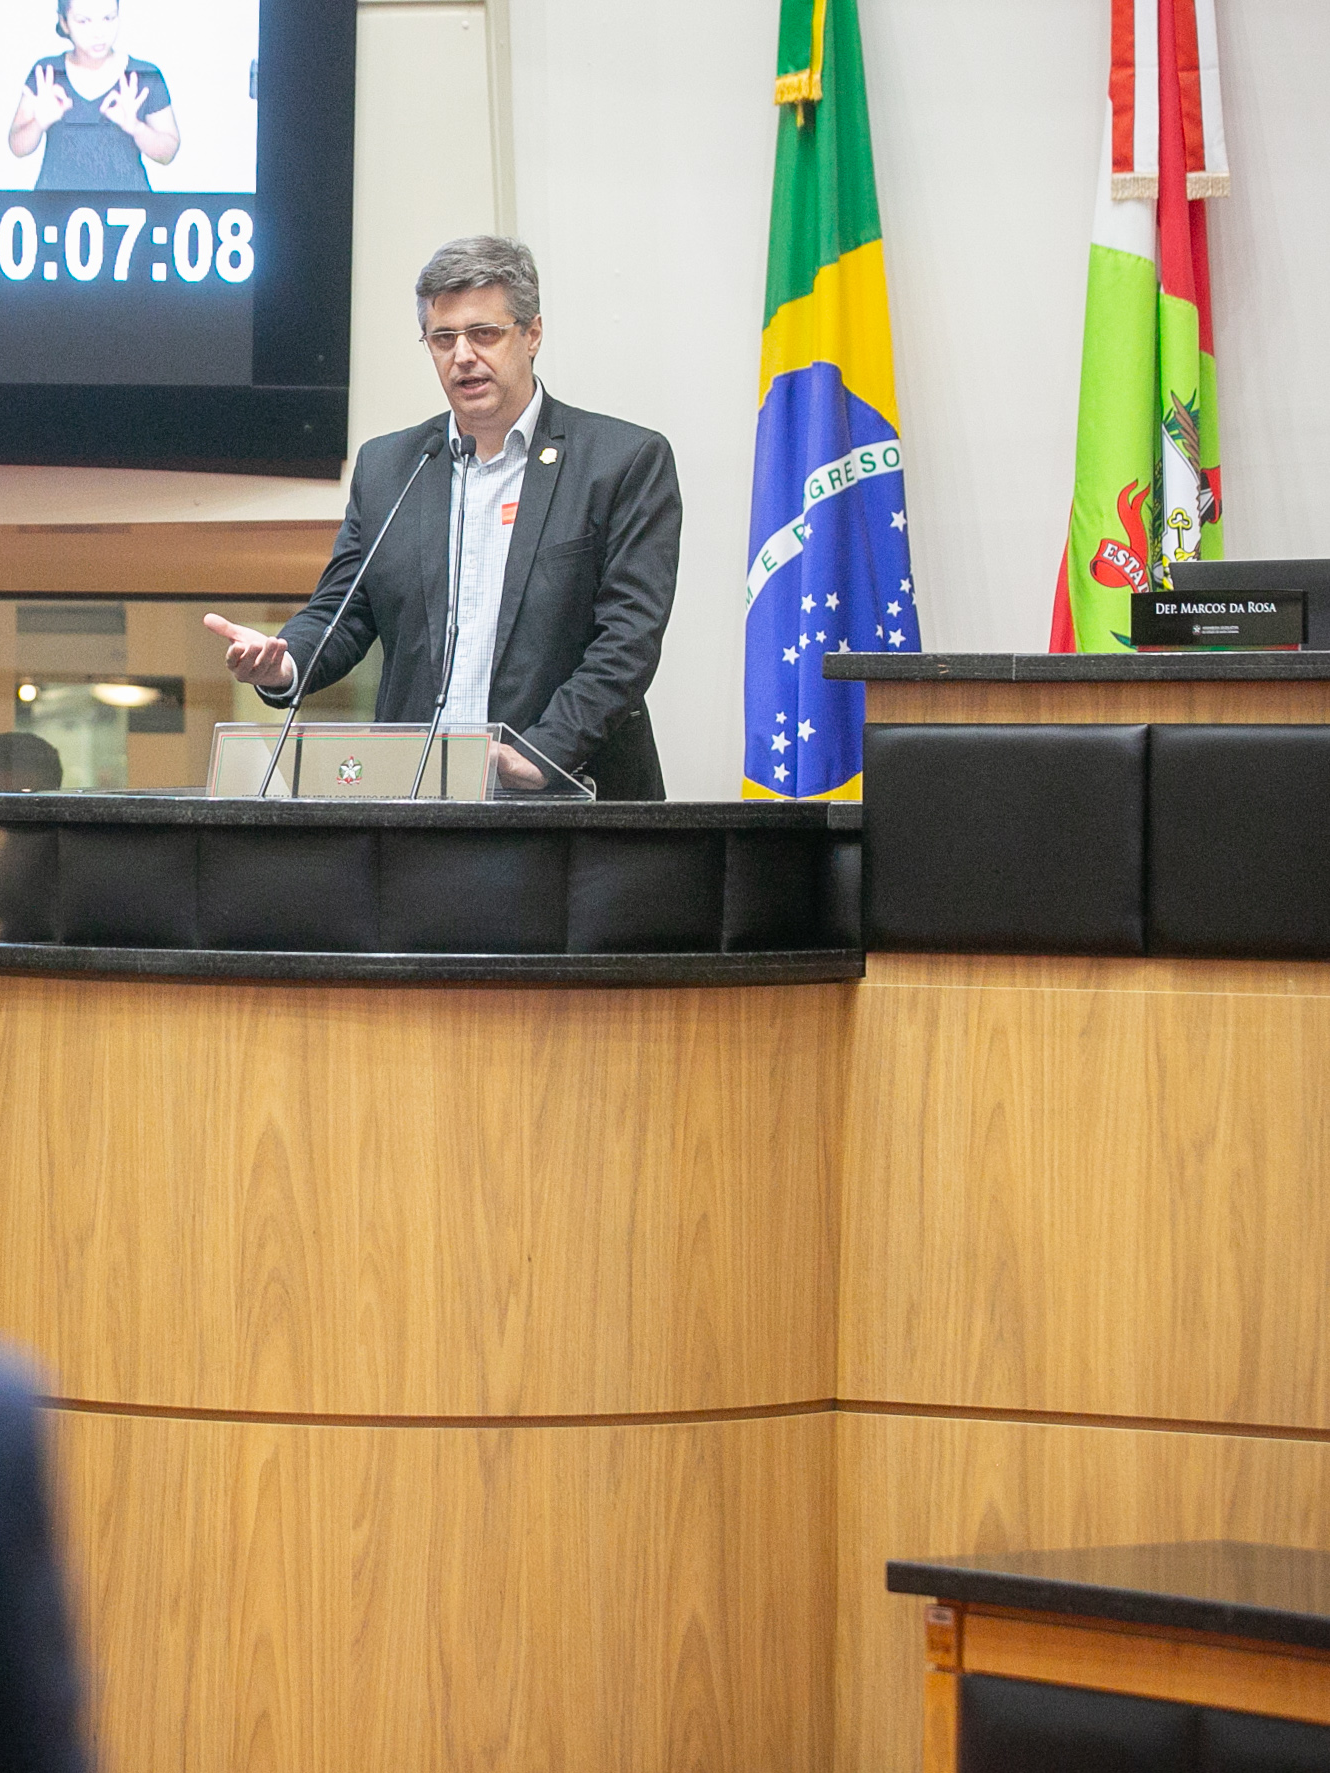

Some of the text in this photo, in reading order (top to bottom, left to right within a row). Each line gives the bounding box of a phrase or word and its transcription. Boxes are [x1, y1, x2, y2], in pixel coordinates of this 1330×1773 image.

[1180, 602, 1226, 614] MARCOS
[1229, 602, 1246, 614] DA
[1247, 601, 1277, 614] ROSA
